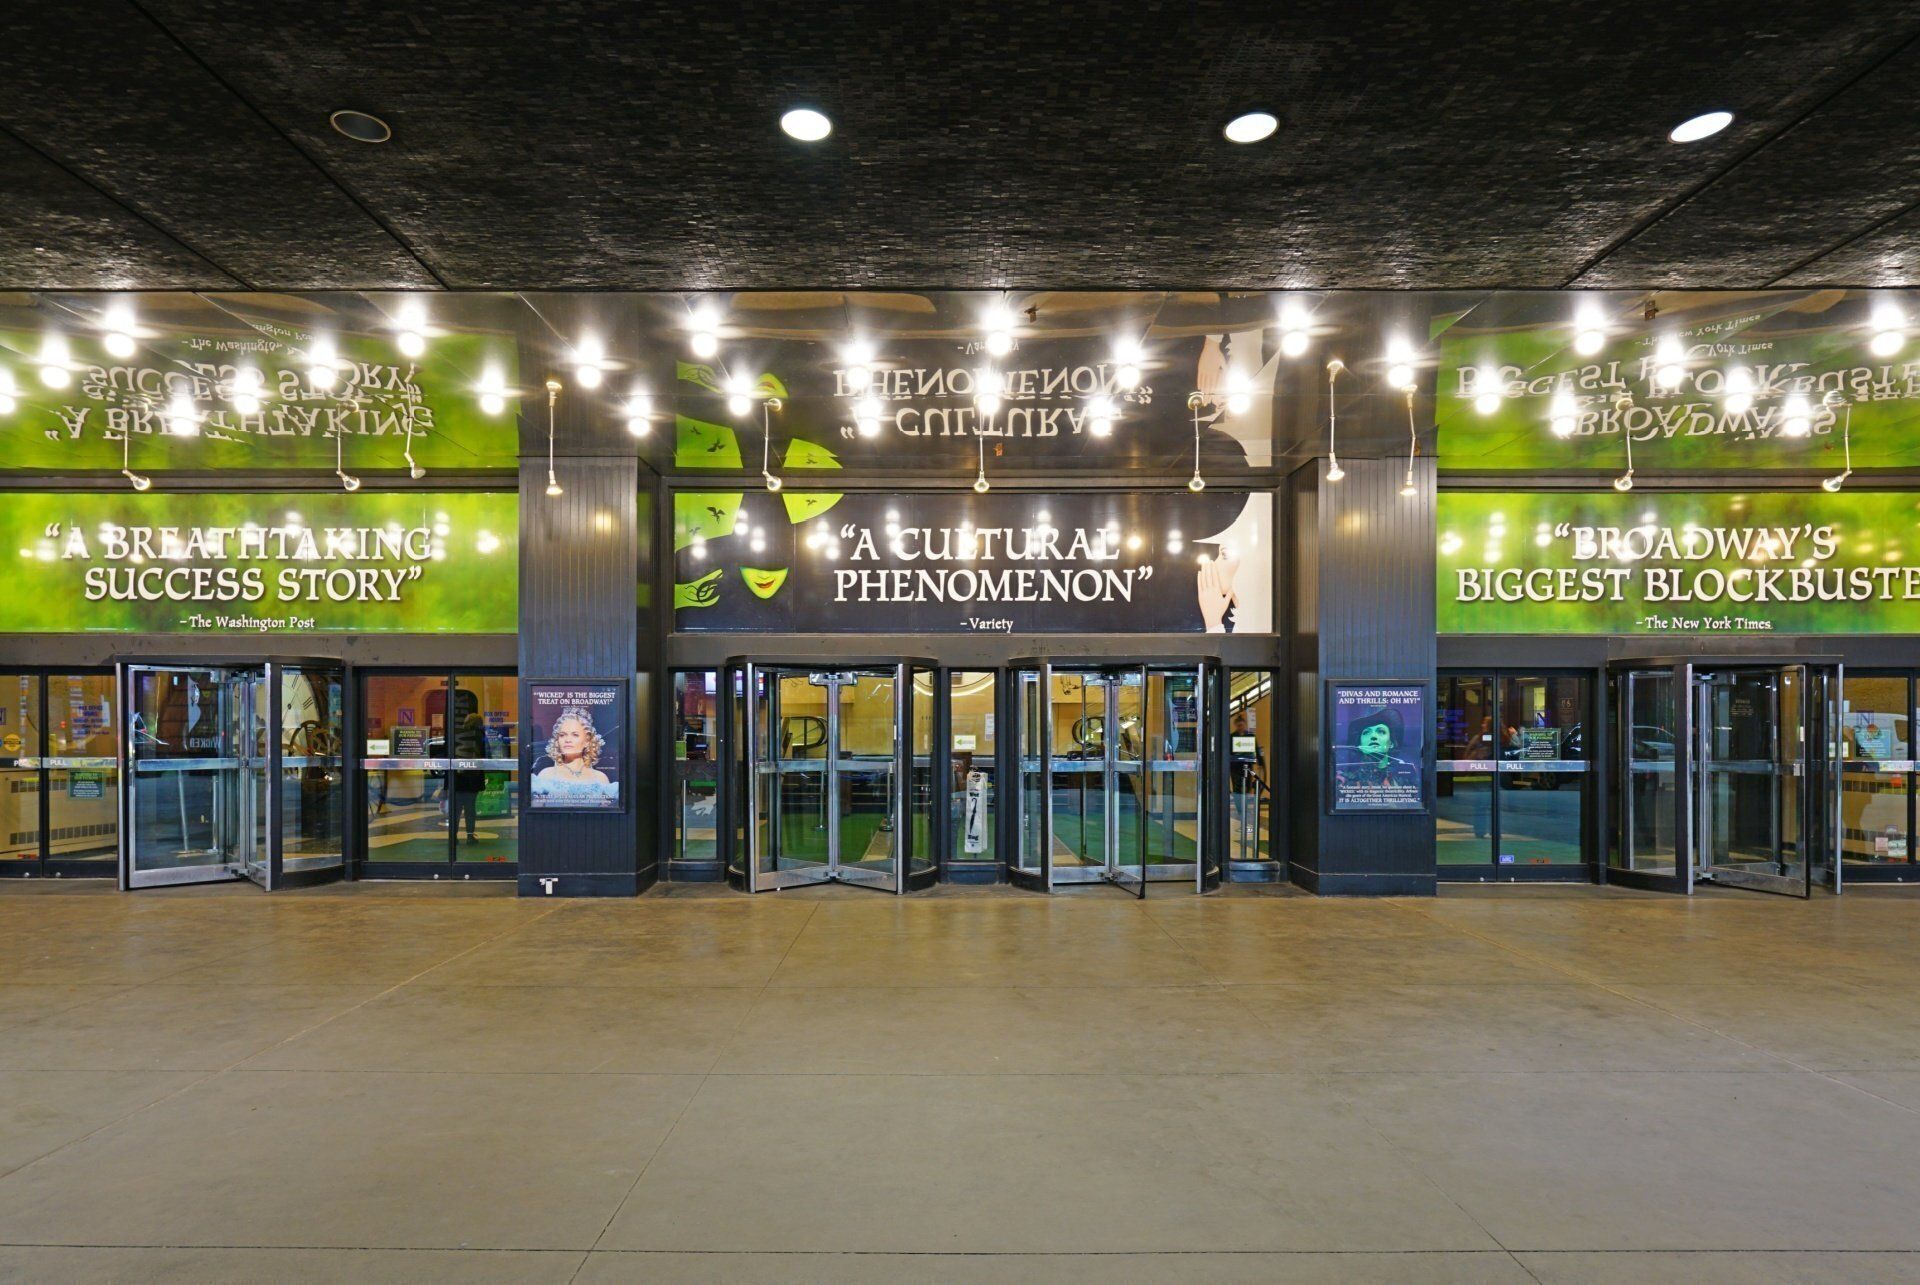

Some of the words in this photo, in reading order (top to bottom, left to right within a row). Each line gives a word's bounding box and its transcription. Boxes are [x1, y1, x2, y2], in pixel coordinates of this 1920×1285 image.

[44, 522, 90, 560] “A
[104, 525, 432, 562] BREATHTAKING
[839, 522, 881, 561] “A
[895, 527, 1120, 561] CULTURAL
[1553, 523, 1837, 561] “BROADWAY’S
[84, 567, 265, 602] SUCCESS
[277, 565, 424, 603] STORY”
[833, 565, 1154, 603] PHENOMENON”
[1456, 567, 1632, 602] BIGGEST
[215, 613, 286, 633] Washington
[289, 616, 315, 629] Post
[1671, 616, 1700, 630] New
[1703, 615, 1732, 630] York
[1734, 617, 1772, 631] Times
[588, 692, 616, 700] BIGGEST
[423, 761, 443, 769] PULL
[458, 761, 478, 769] PULL
[1469, 762, 1488, 770] PULL
[1506, 762, 1524, 770] PULL
